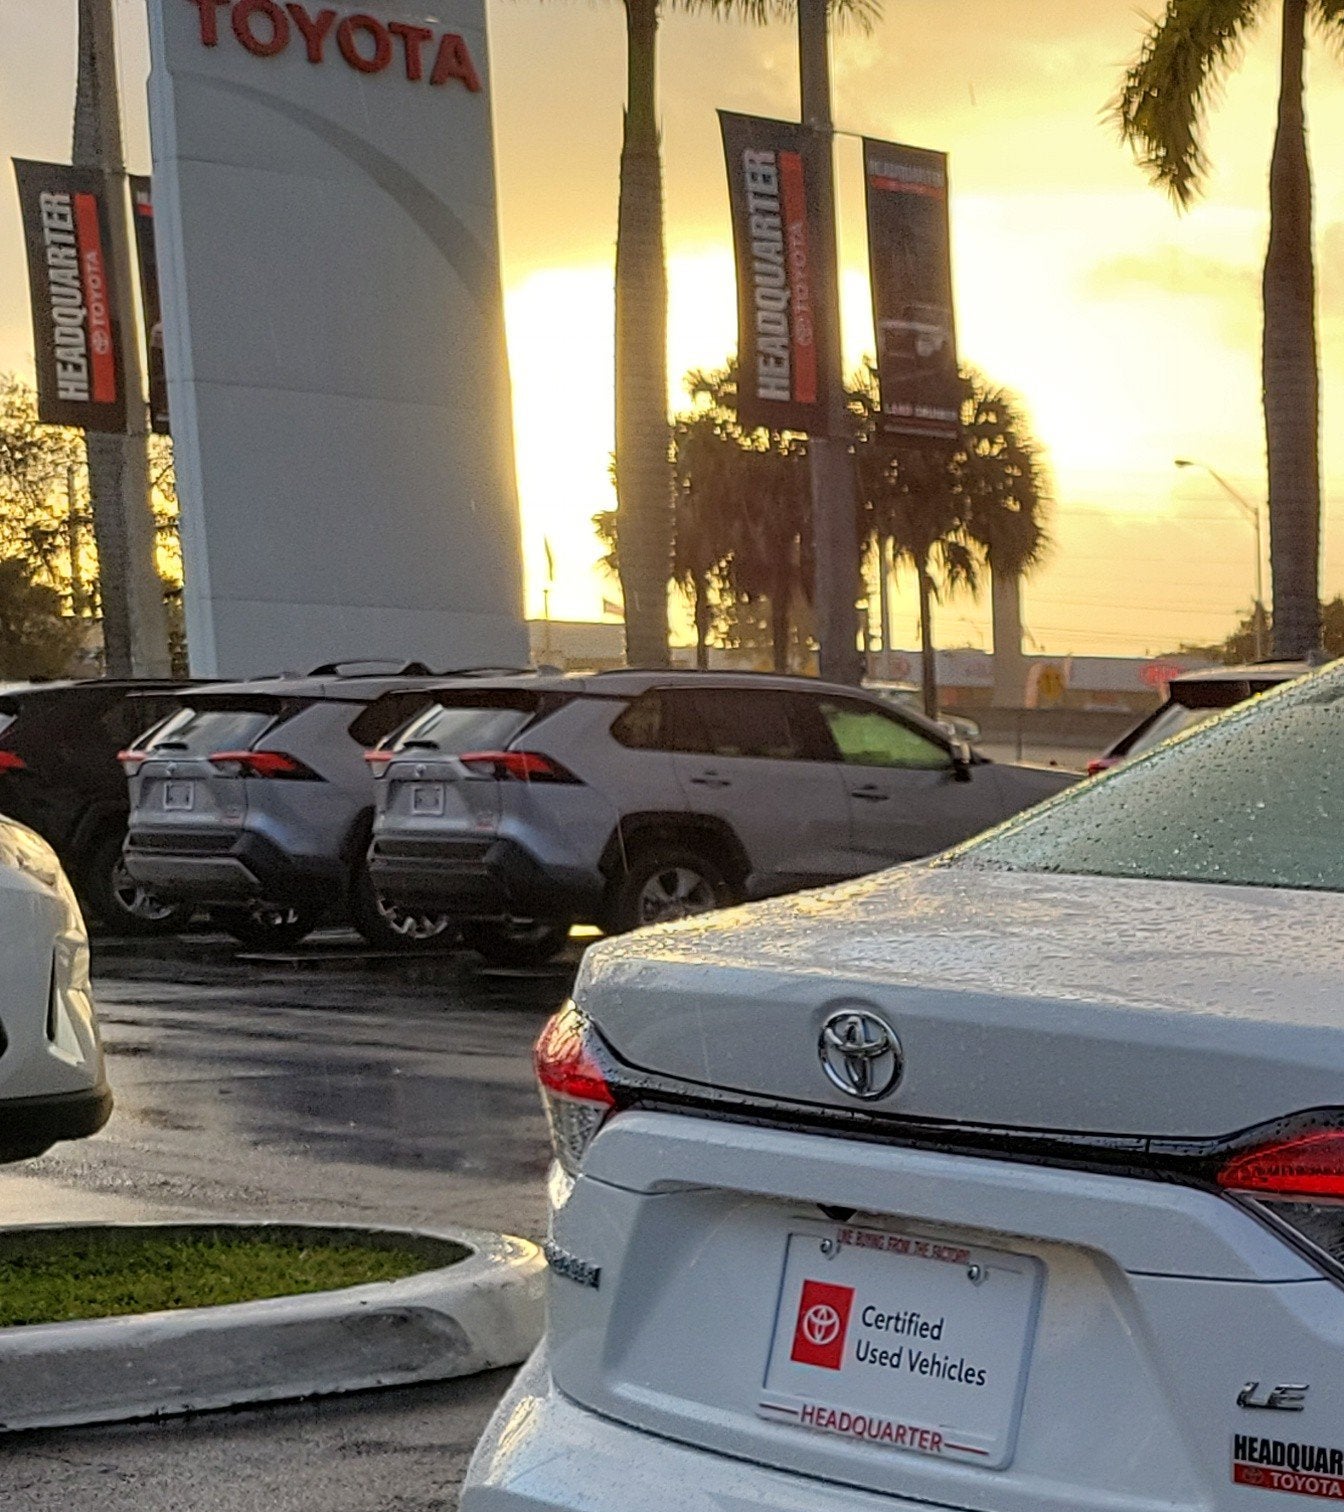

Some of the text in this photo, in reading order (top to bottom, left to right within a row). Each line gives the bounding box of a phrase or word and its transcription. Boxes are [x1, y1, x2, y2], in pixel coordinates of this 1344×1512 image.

[190, 0, 482, 92] TOYOTA
[40, 191, 89, 401] HEADQUARTER
[86, 252, 106, 325] TOYOTA
[744, 150, 791, 401] HEADQUARTER
[790, 222, 810, 310] TOYOTA
[862, 1305, 944, 1341] Certified
[856, 1339, 987, 1386] Used Vehicles
[1236, 1382, 1310, 1411] LE
[801, 1404, 943, 1451] HEADQUARTER
[1270, 1472, 1343, 1497] TOYOTA
